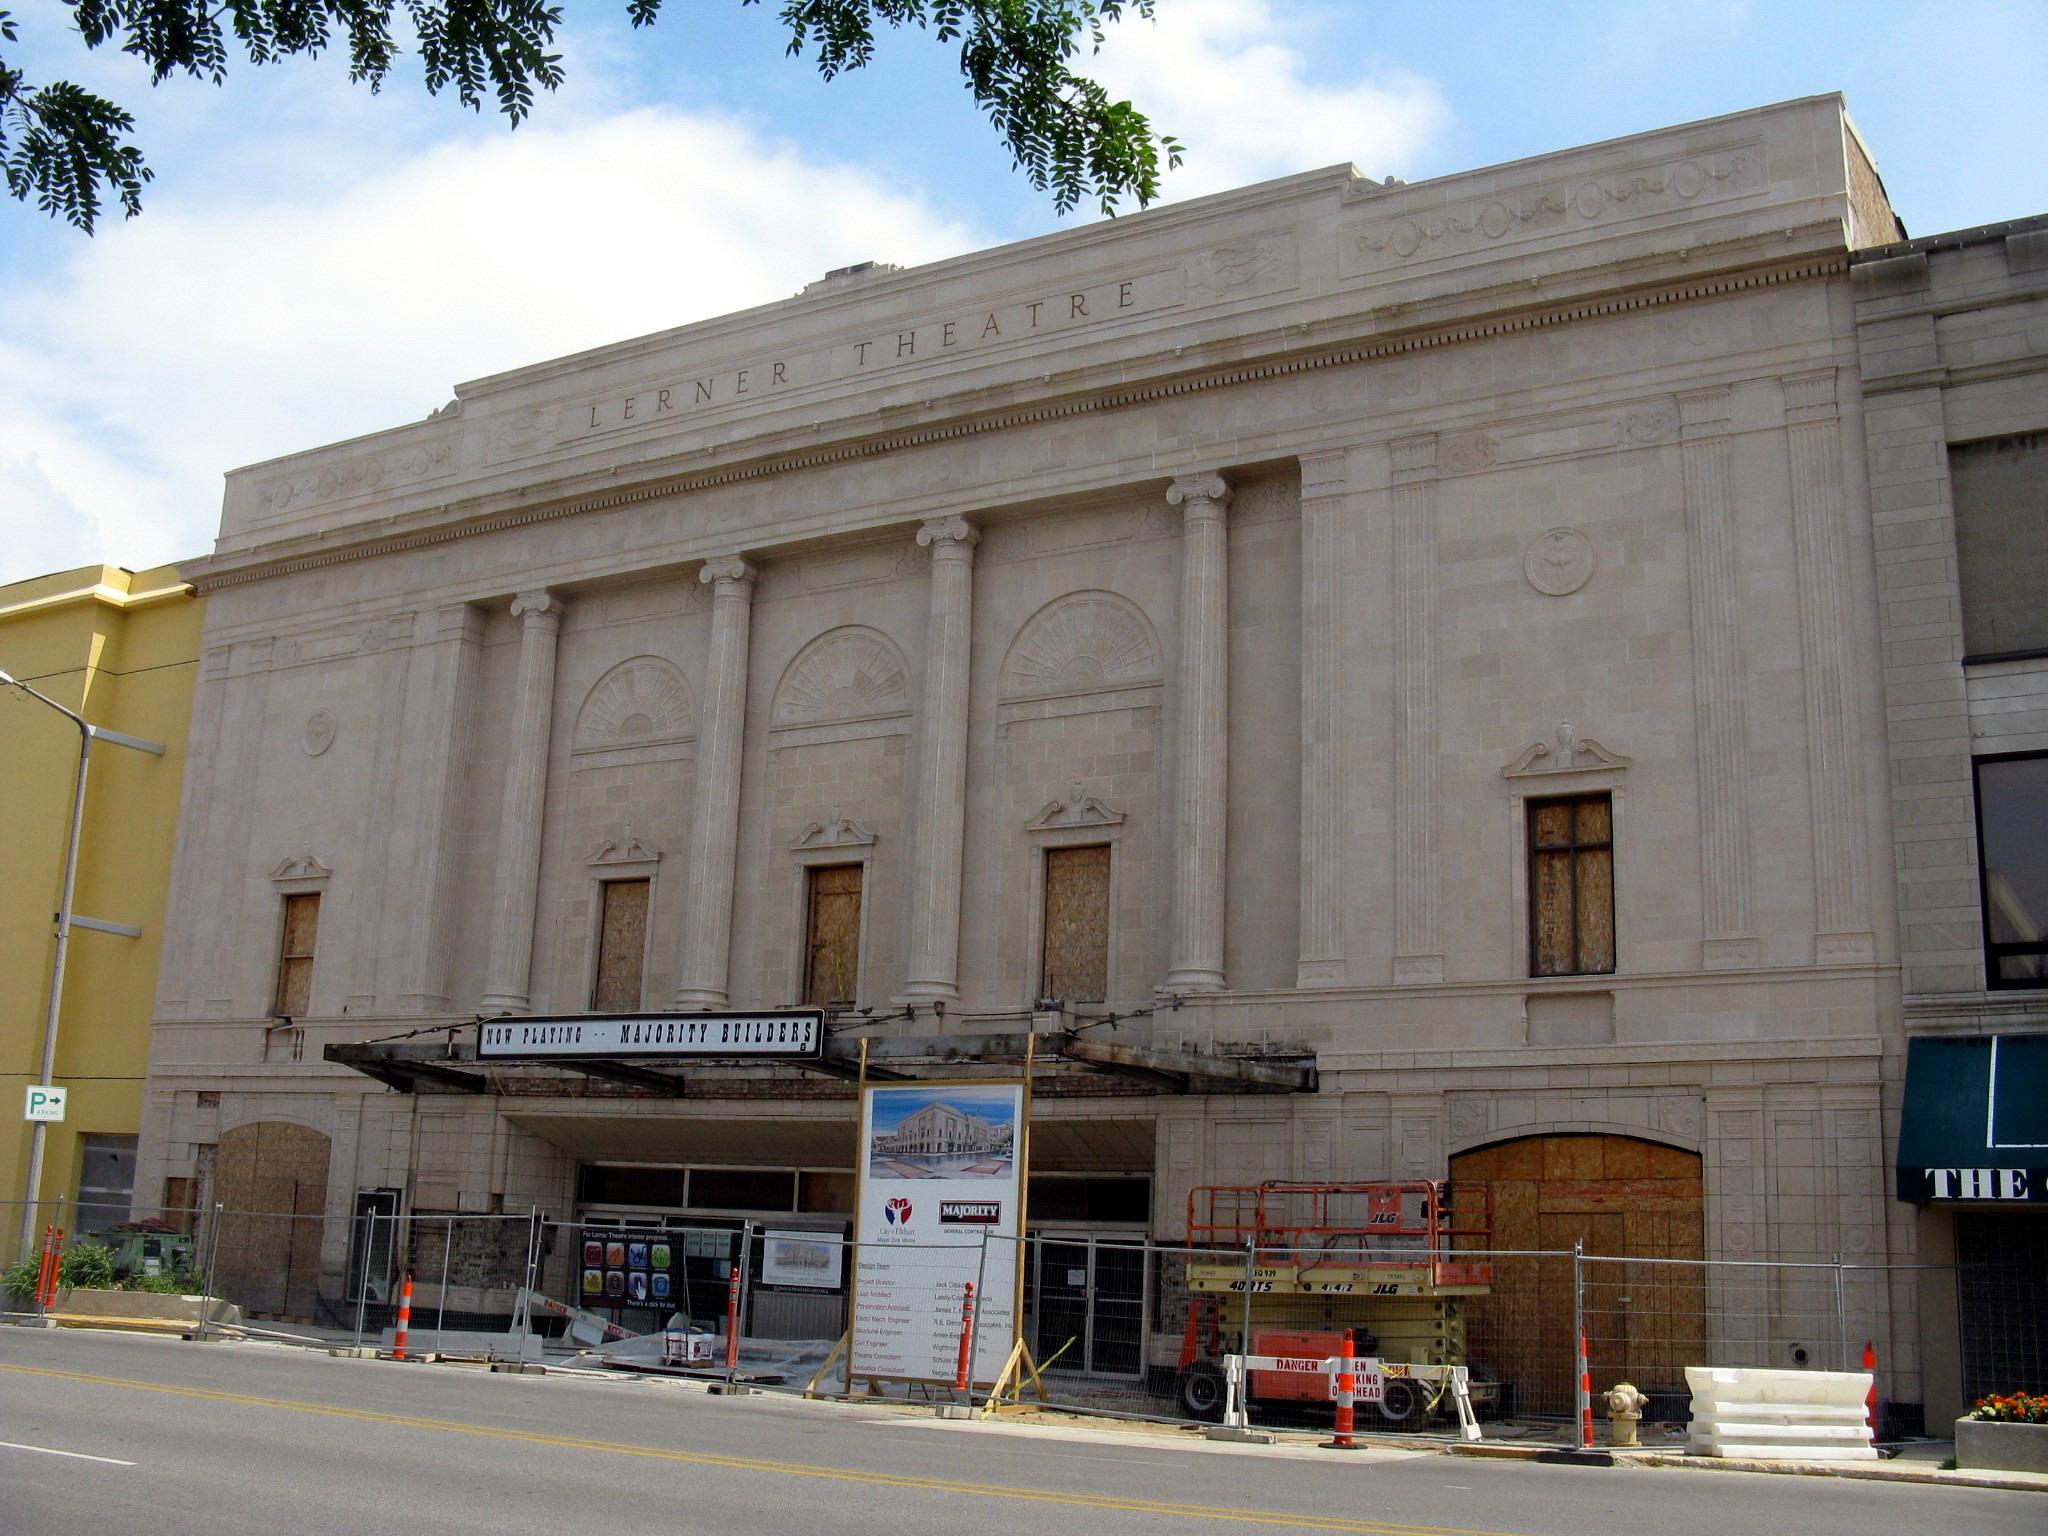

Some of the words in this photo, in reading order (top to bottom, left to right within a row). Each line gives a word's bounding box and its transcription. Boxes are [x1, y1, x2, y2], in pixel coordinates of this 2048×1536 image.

[590, 362, 789, 428] LERNER
[854, 282, 1134, 366] THEATRE
[486, 1027, 512, 1045] NOW
[522, 1026, 582, 1044] PLAYING
[620, 1023, 708, 1044] MAJORITY
[721, 1021, 811, 1043] BUILDERS
[1925, 1168, 2028, 1199] THE
[942, 1204, 998, 1219] MAJORITY
[1371, 1213, 1397, 1223] JLG
[1373, 1284, 1399, 1294] JLG
[1276, 1359, 1318, 1372] DANGER
